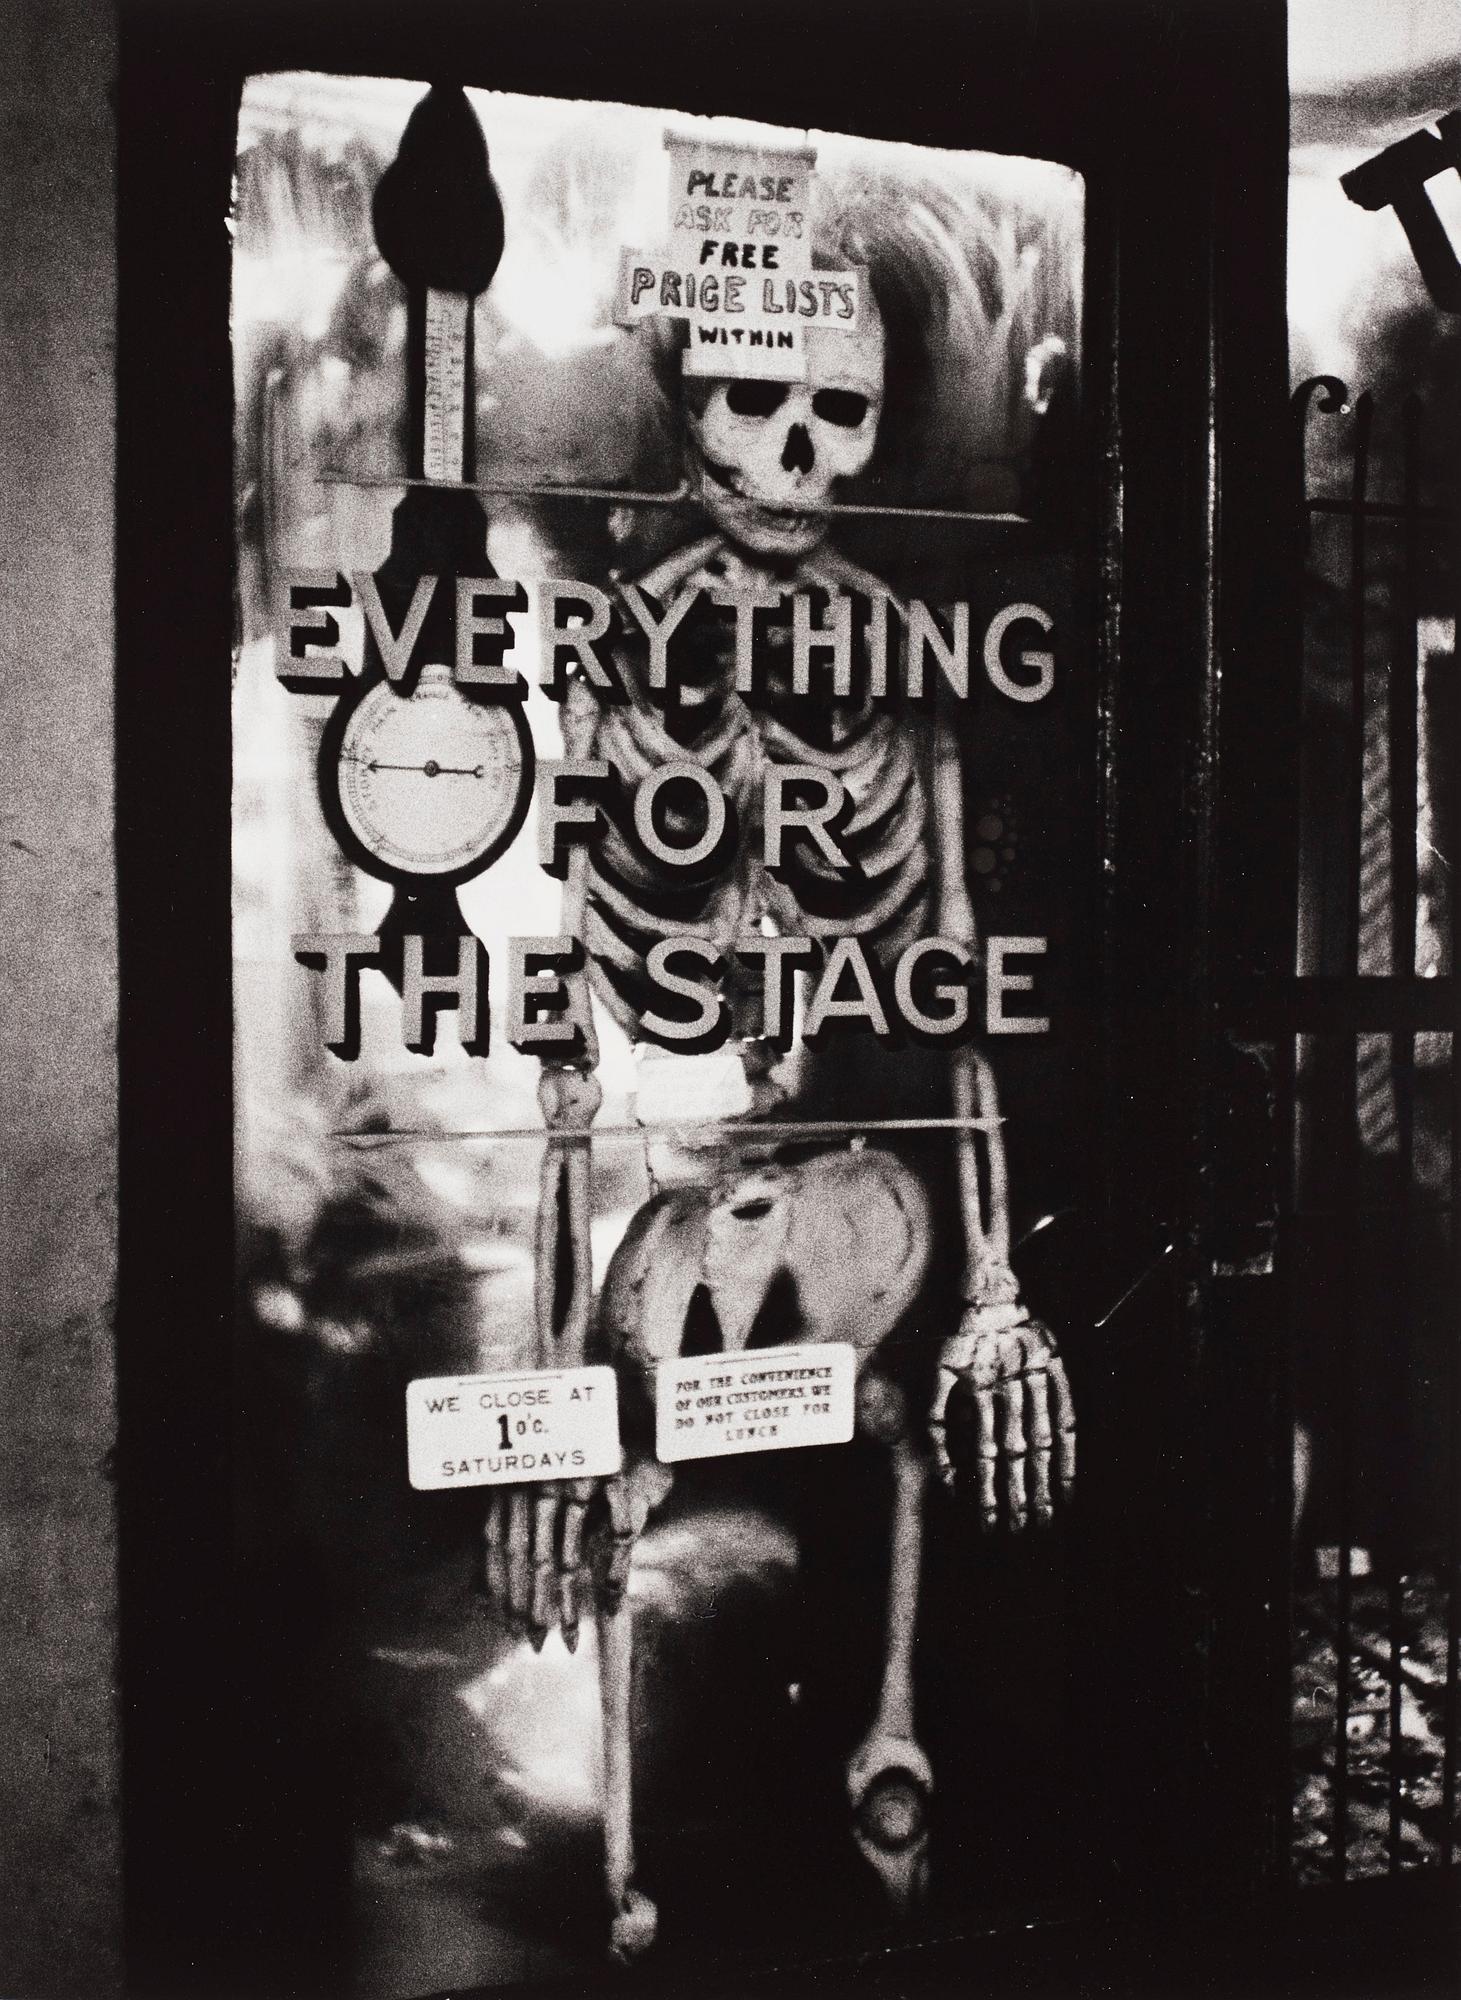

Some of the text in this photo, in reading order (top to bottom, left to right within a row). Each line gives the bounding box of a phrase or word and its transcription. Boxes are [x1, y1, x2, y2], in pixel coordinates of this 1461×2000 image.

[687, 169, 794, 202] PLEASE
[674, 203, 803, 239] ASK FOR
[700, 240, 779, 269] FREE
[762, 278, 854, 318] LISTS
[698, 326, 793, 348] WITHIN
[273, 568, 1056, 704] EVERYTHING
[534, 759, 854, 874] FOR
[290, 933, 1052, 1053] THE STAGE
[676, 1366, 832, 1393] FOR THE CONVENIENCE
[425, 1386, 595, 1414] WE CLOSE AT
[675, 1400, 692, 1411] OF
[696, 1395, 721, 1408] OUR
[812, 1385, 831, 1396] WE
[676, 1402, 831, 1429] DO NOT CLOSE FOR
[726, 1425, 778, 1441] LUNCH
[442, 1450, 586, 1477] SATURDAYS
